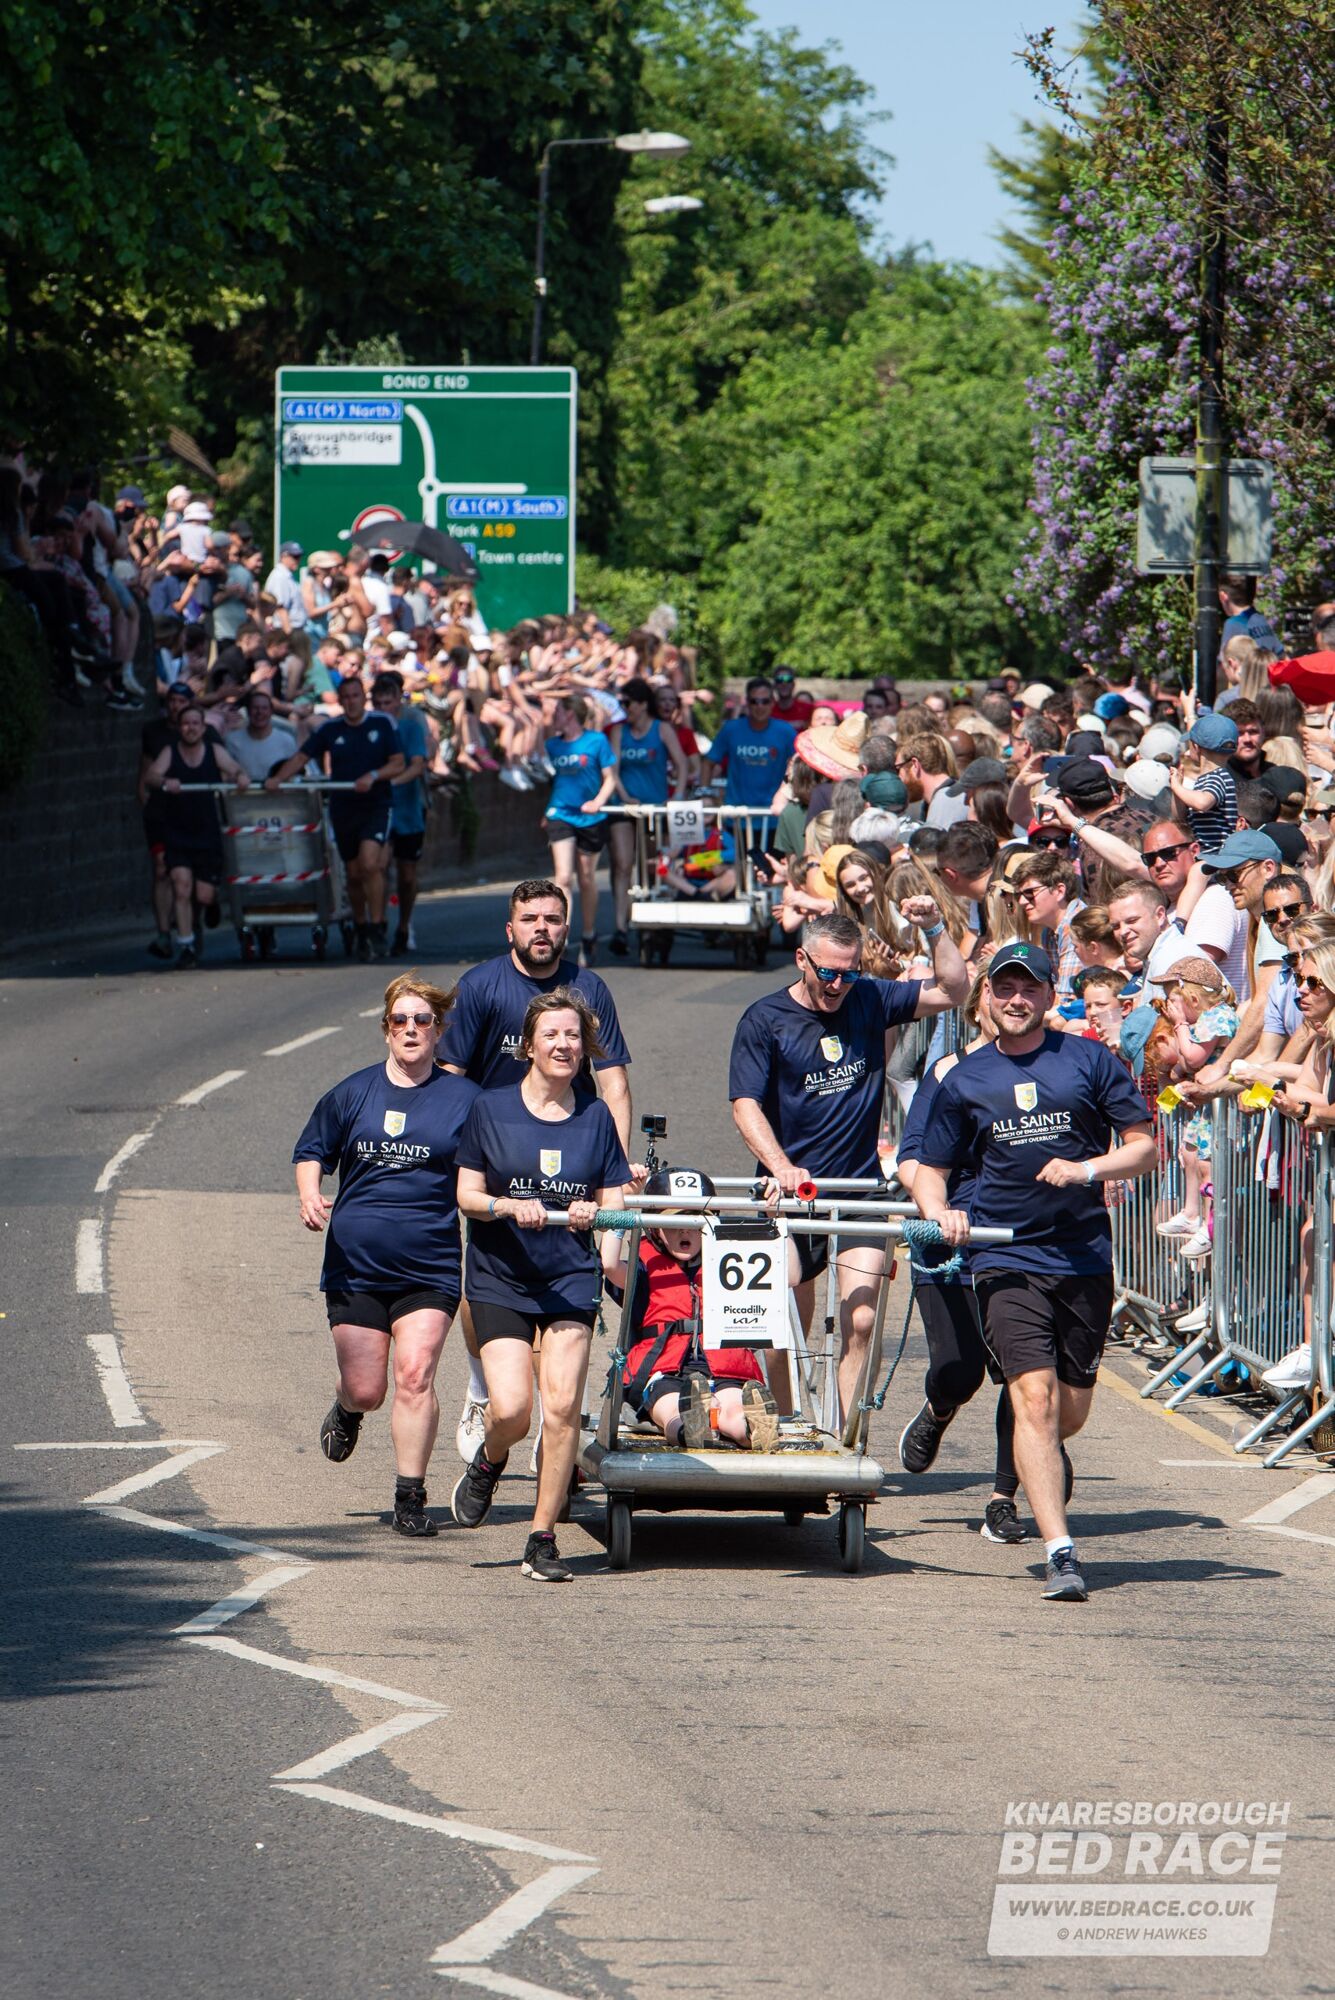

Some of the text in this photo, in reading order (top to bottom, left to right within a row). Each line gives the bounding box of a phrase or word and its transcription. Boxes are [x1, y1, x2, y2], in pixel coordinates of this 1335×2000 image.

[382, 374, 470, 390] BOND END
[446, 523, 517, 538] York A59
[477, 549, 565, 565] Town centre
[673, 810, 698, 827] 59
[804, 1071, 826, 1085] ALL
[828, 1057, 866, 1081] SAINTS
[992, 1111, 1072, 1134] ALL SAINTS
[993, 1131, 1016, 1140] CHURCH
[1023, 1126, 1050, 1135] ENGLAND
[1049, 1123, 1072, 1132] SCHOOL
[357, 1141, 431, 1159] ALL SAINTS
[508, 1177, 588, 1197] ALL SAINTS
[674, 1175, 699, 1189] 62
[718, 1252, 773, 1291] 62
[723, 1304, 768, 1316] Piccadilly
